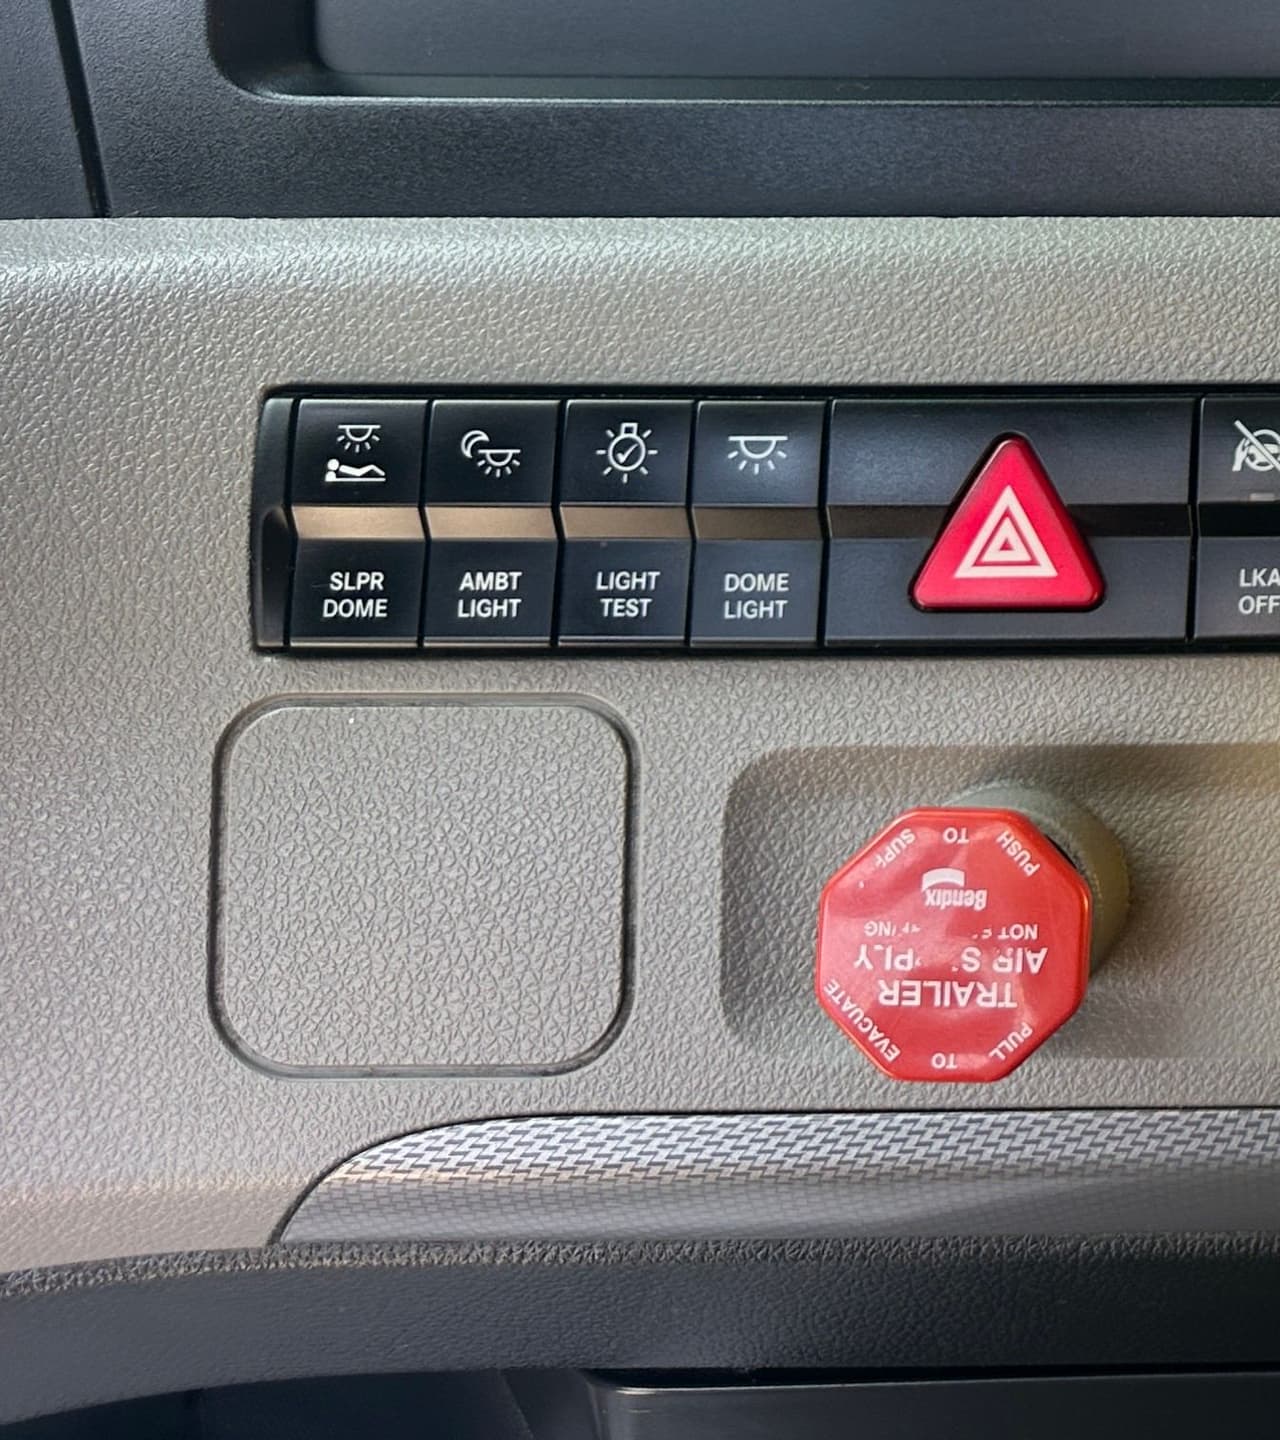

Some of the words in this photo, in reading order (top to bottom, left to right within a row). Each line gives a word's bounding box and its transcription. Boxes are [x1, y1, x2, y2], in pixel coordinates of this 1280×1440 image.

[329, 571, 385, 592] SLPR
[459, 571, 522, 592] AMBT
[596, 571, 660, 591] LIGHT
[724, 573, 790, 594] DOME
[322, 598, 388, 619] DOME
[456, 598, 522, 620] LIGHT
[600, 597, 652, 618] TEST
[723, 599, 788, 620] LIGHT
[1238, 594, 1280, 615] OFF
[943, 827, 969, 844] TO
[996, 830, 1041, 877] PUSH
[925, 888, 988, 911] Bendix
[997, 924, 1039, 940] NOT
[878, 979, 1018, 1009] TRAILER
[824, 979, 901, 1062] EVACUATE
[988, 1022, 1034, 1061] PULL
[931, 1053, 958, 1070] TO
